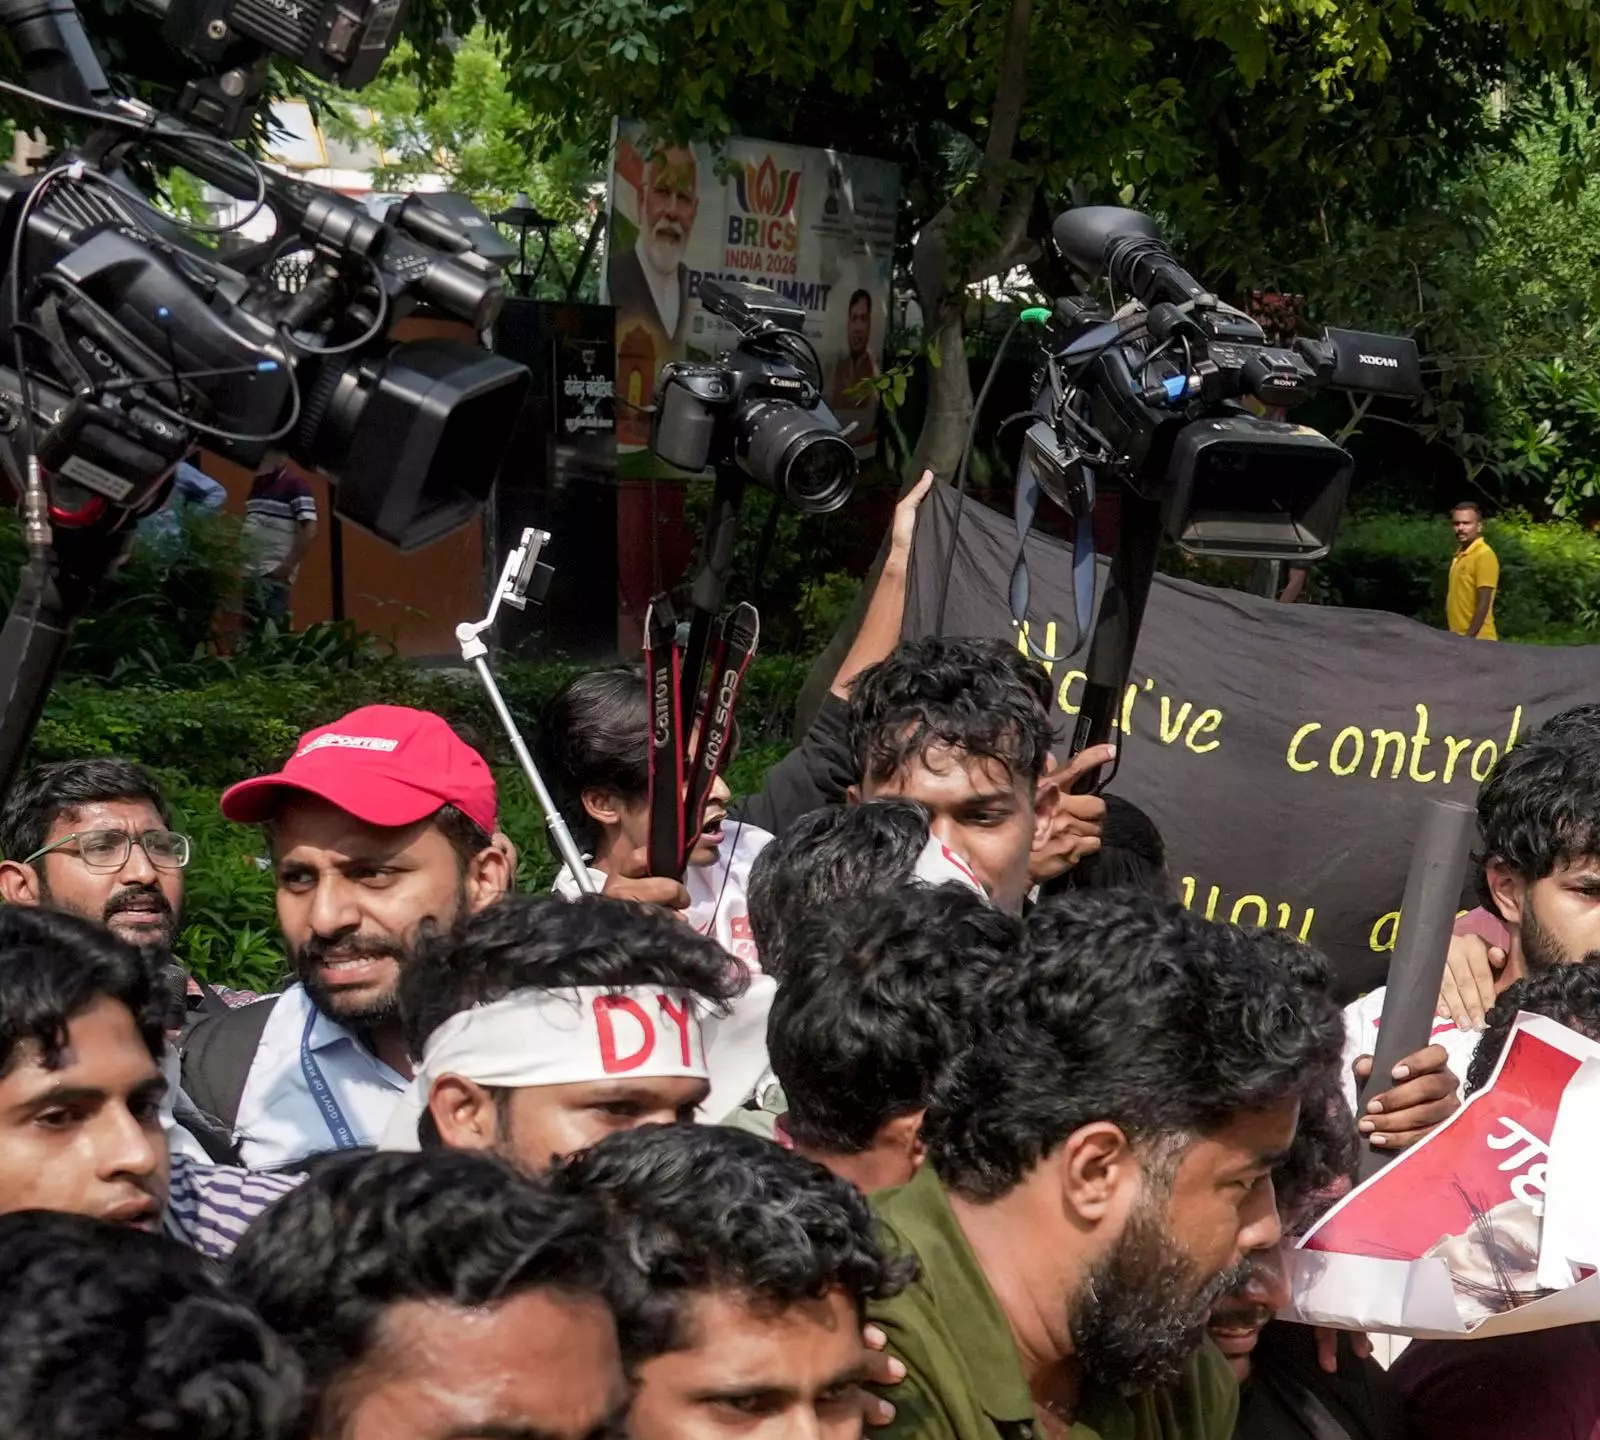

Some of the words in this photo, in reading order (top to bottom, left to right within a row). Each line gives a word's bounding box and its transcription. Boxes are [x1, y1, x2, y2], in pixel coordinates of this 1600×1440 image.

[728, 215, 797, 252] BRICS
[726, 249, 763, 269] INDIA
[767, 252, 798, 275] 2026
[1357, 354, 1399, 369] XDCAM
[769, 376, 802, 388] Canon
[1273, 379, 1298, 388] SONY
[654, 666, 669, 748] Canon
[715, 669, 740, 727] EOS
[704, 728, 724, 772] 80D
[593, 994, 692, 1073] DY
